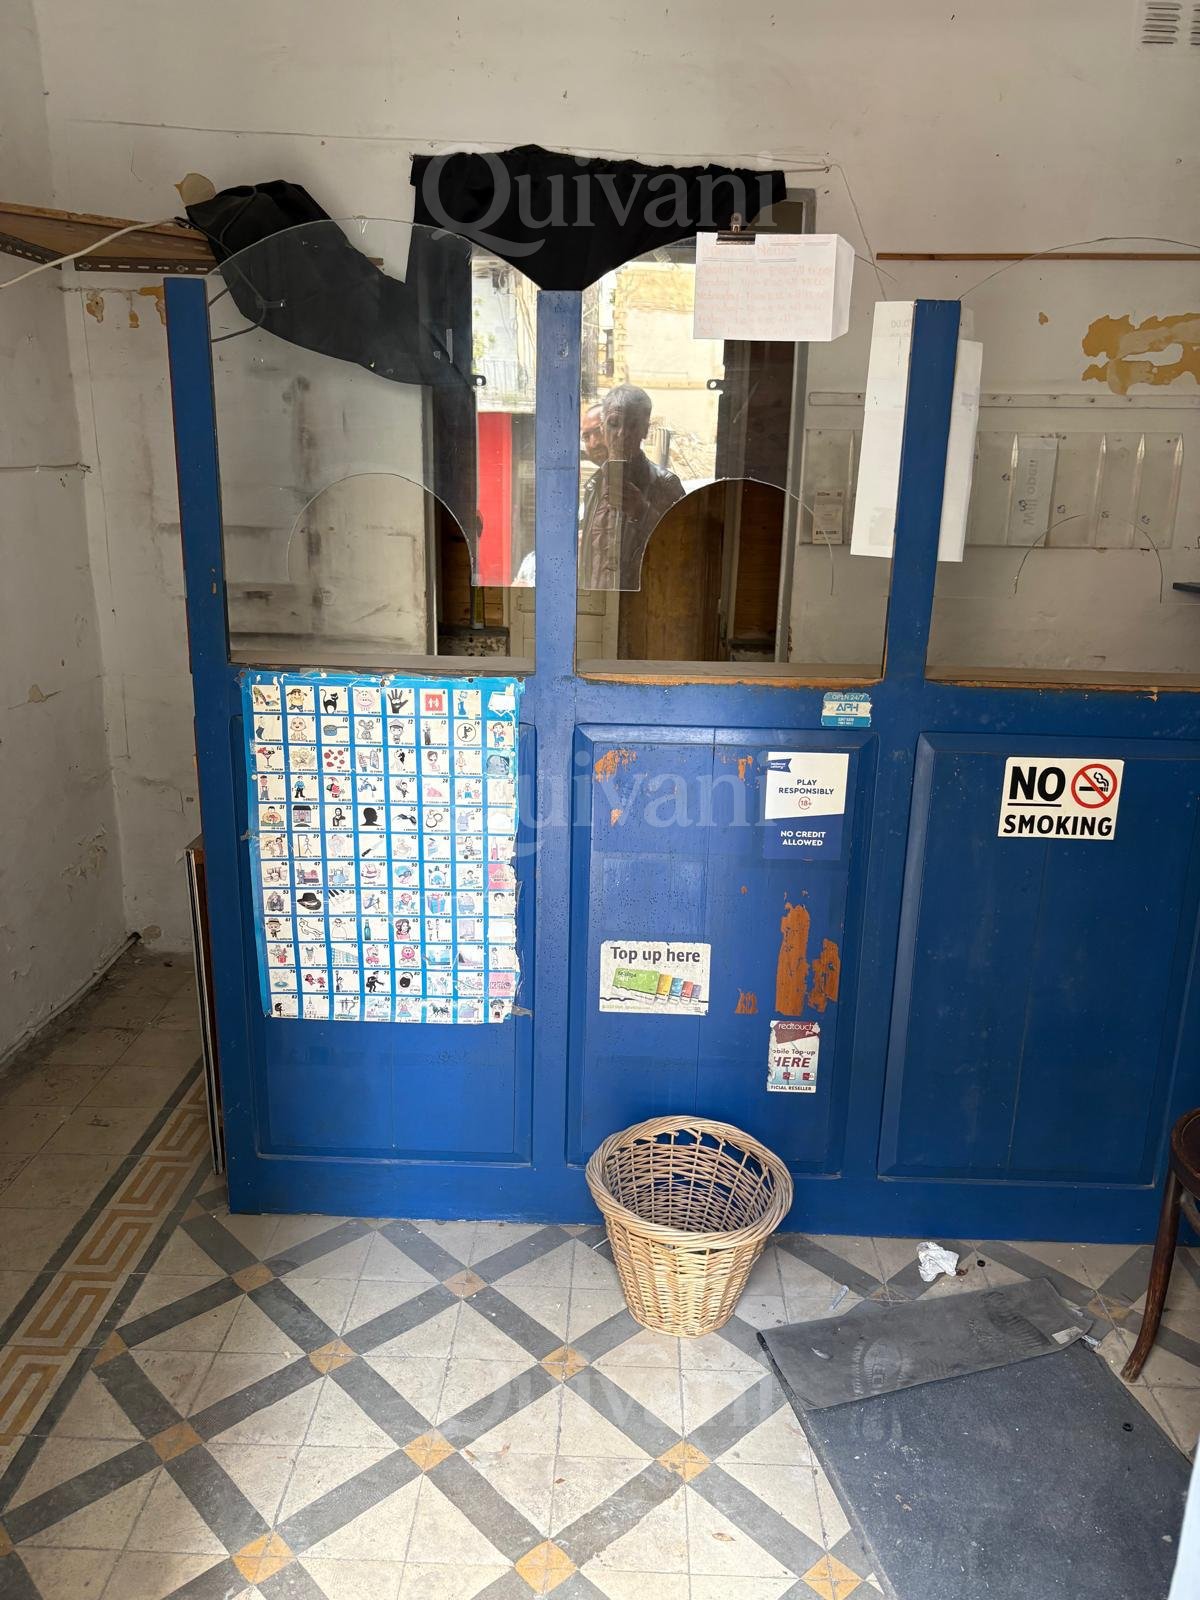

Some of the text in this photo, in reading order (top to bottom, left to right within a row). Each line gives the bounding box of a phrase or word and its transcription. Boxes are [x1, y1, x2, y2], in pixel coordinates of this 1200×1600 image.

[778, 787, 834, 795] RESPONSIBLY
[1008, 765, 1066, 802] NO
[1003, 814, 1113, 836] SMOKING
[782, 839, 823, 847] ALLOWED
[610, 946, 700, 964] Top up here
